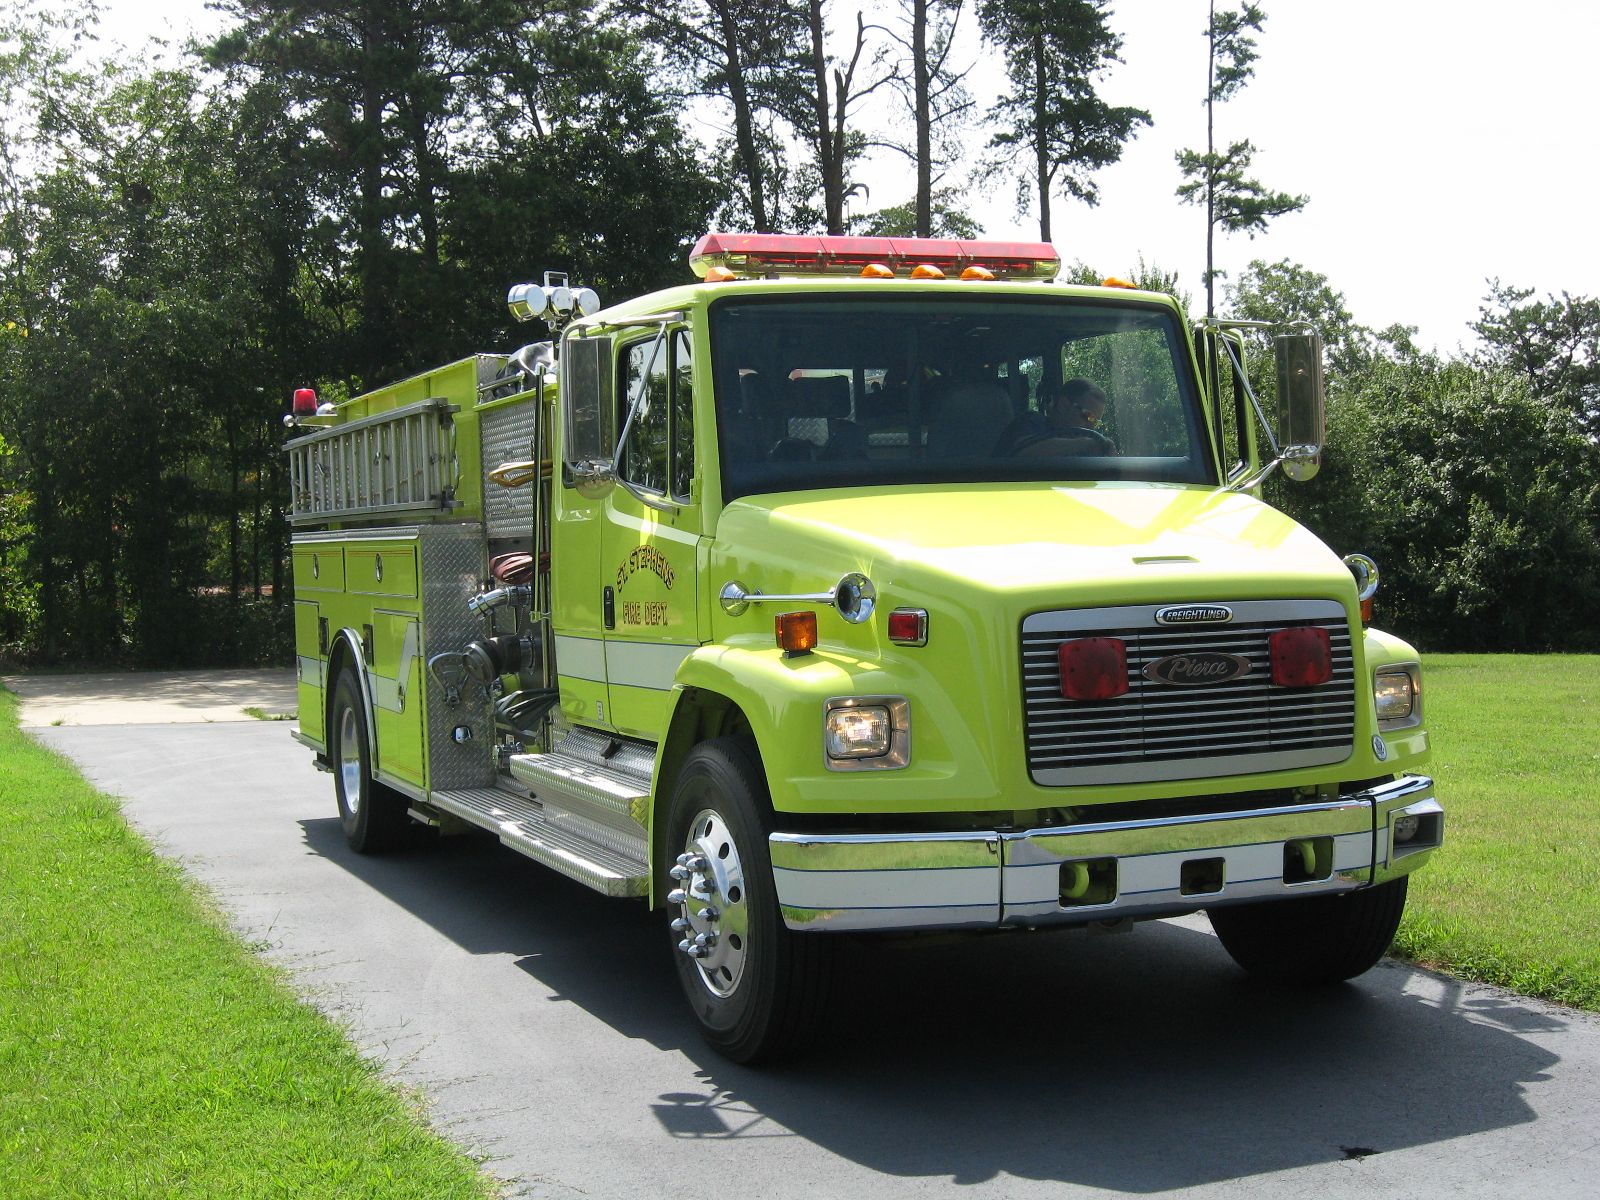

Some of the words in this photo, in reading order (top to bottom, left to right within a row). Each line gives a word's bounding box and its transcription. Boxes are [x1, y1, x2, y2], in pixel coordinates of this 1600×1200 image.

[629, 545, 675, 591] STEPHENS
[623, 601, 641, 624] FIRE
[645, 602, 668, 626] DEPT.
[1166, 609, 1226, 621] FREIGHTLINER
[1167, 657, 1229, 681] Pierce
